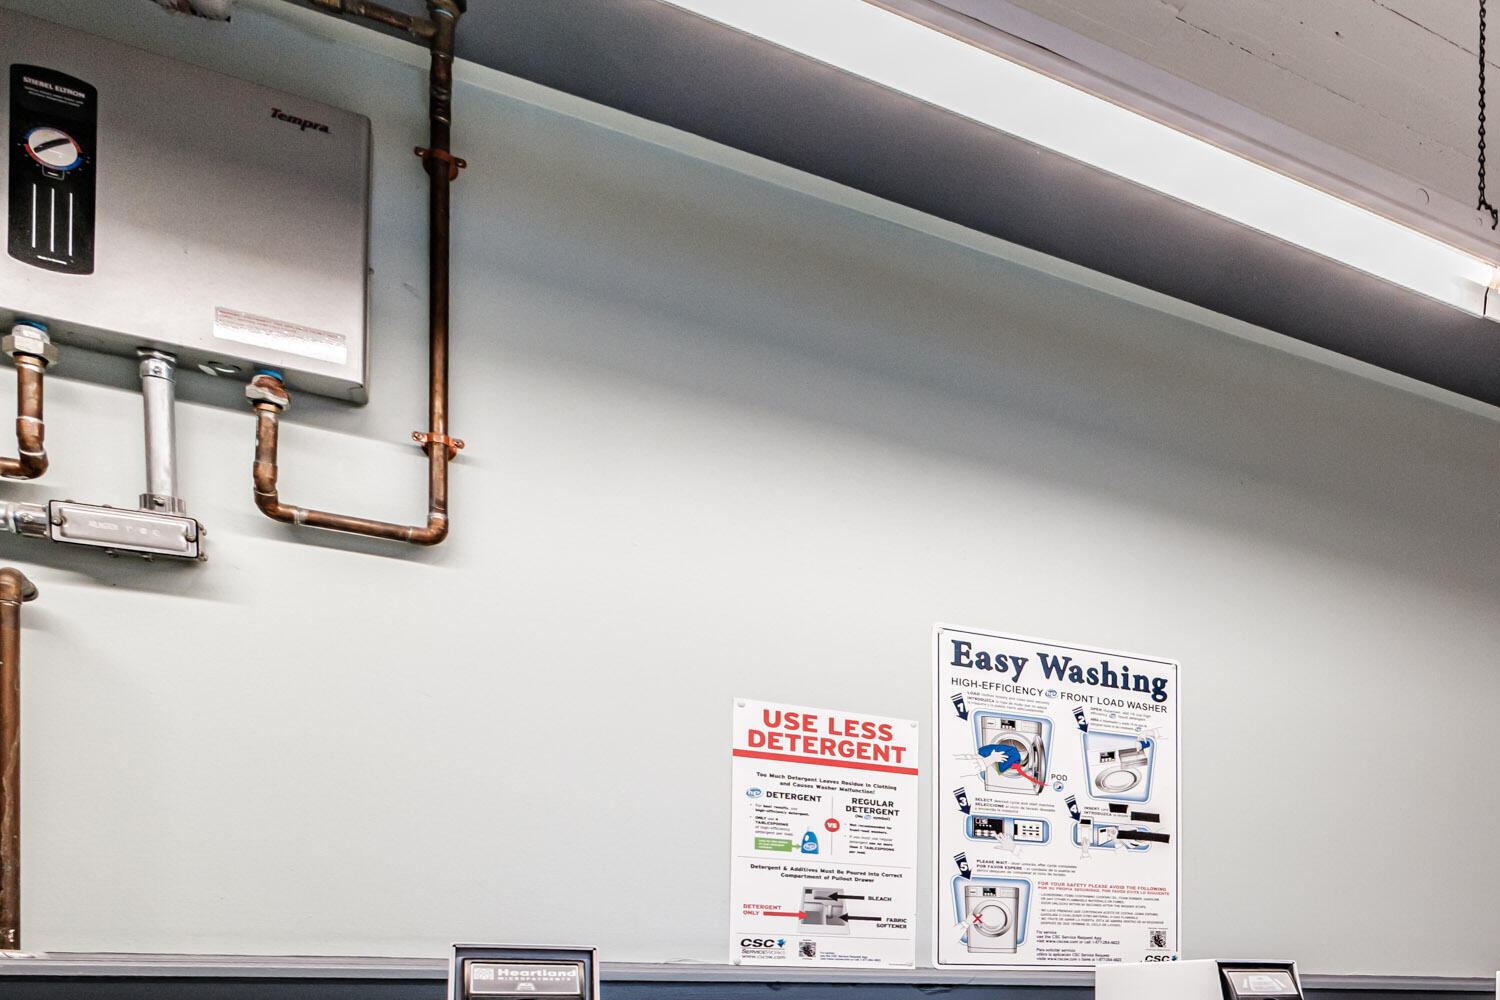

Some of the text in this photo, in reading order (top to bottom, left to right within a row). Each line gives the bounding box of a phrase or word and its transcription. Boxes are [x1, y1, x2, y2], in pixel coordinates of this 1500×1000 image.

[23, 76, 54, 90] STIEBEL
[54, 85, 86, 99] ELTRON
[270, 107, 330, 132] Tempra
[950, 639, 1029, 683] Easy
[1037, 652, 1168, 703] Washing
[951, 676, 1044, 697] HIGH-EFFICIENCY
[1060, 691, 1093, 704] FRONT
[1097, 696, 1124, 708] LOAD
[1127, 700, 1168, 714] WASHER
[957, 702, 964, 713] 1
[1078, 715, 1086, 725] 2
[763, 709, 893, 742] USE LESS
[748, 729, 906, 763] DETERGENT
[1051, 773, 1068, 781] POD
[787, 775, 817, 783] Detergent
[873, 783, 897, 792] Clothing
[766, 791, 822, 802] DETERGENT
[959, 797, 967, 806] 3
[851, 797, 894, 808] REGULAR
[845, 805, 900, 816] DETERGENT
[1070, 804, 1078, 813] 4
[750, 863, 781, 871] Detergent
[960, 862, 968, 872] 5
[780, 873, 822, 881] Compartment
[742, 903, 783, 911] DETERGENT
[740, 938, 775, 948] CSC
[1145, 954, 1170, 962] CSC
[498, 968, 577, 977] Heartland
